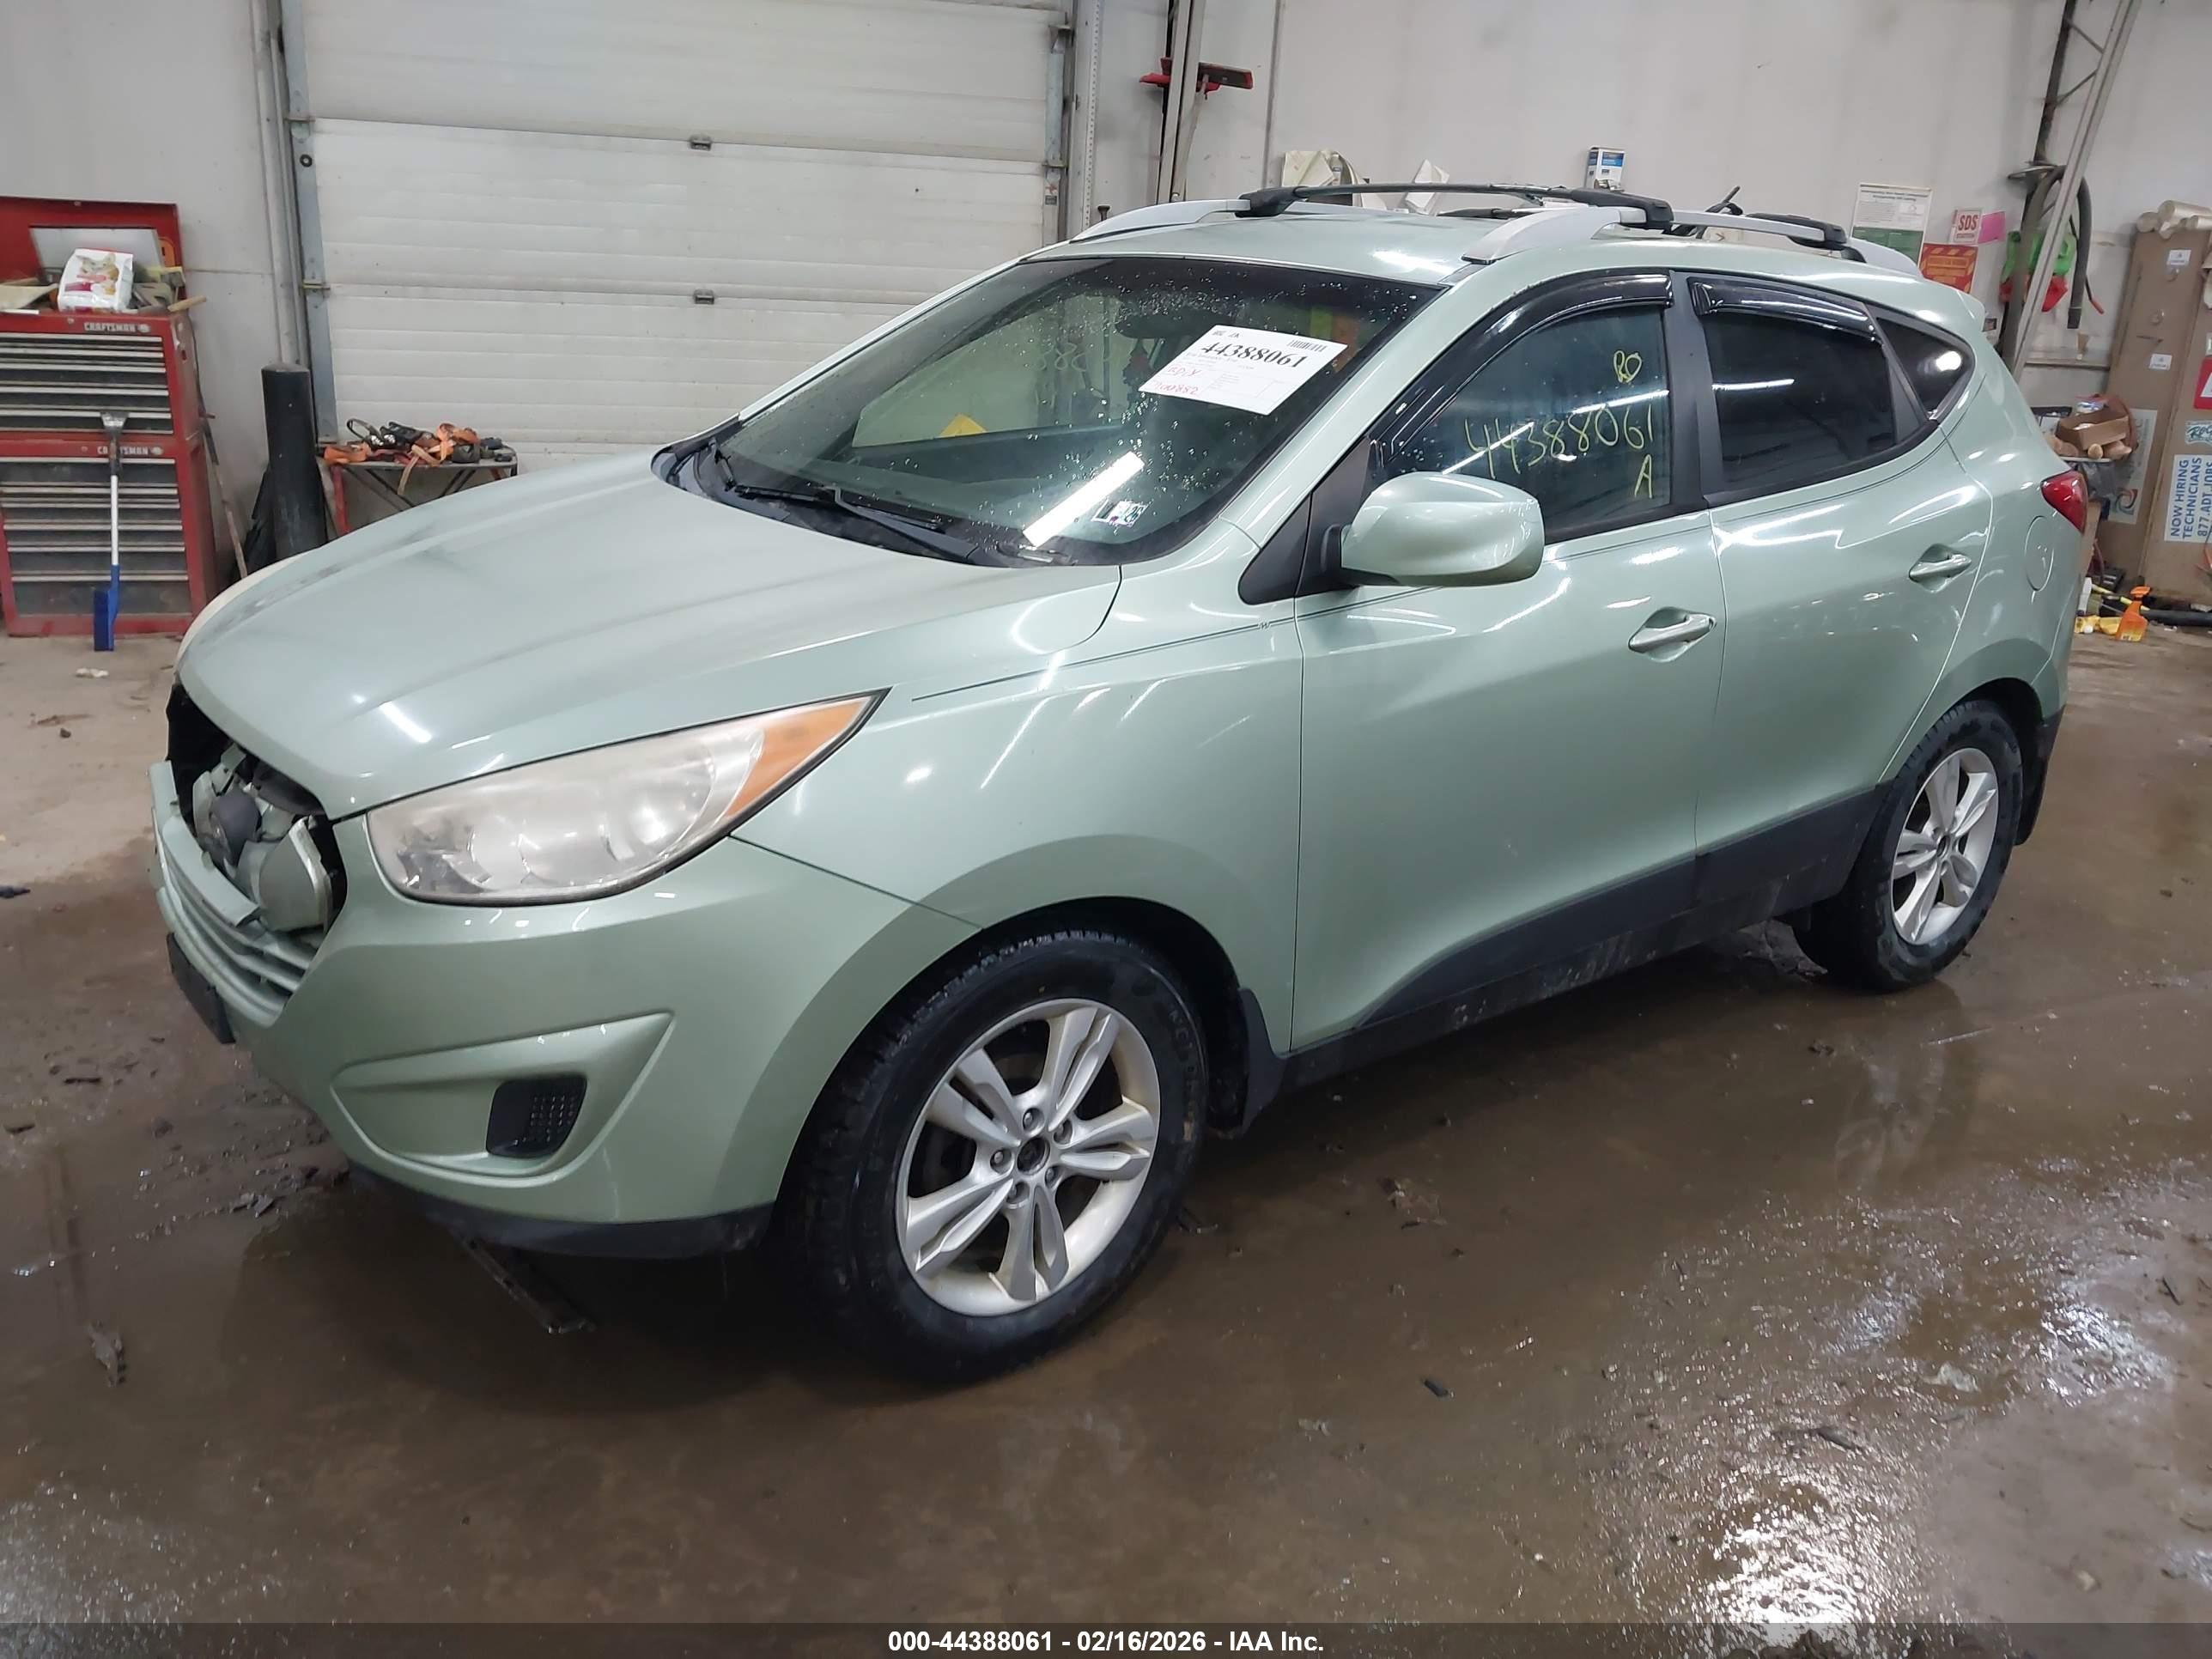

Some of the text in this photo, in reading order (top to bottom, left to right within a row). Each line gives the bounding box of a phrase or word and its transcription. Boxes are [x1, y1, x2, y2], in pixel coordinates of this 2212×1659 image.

[1958, 215, 1978, 231] SDS
[1201, 342, 1309, 369] 44388061
[1465, 403, 1654, 479] 44388061
[1634, 454, 1653, 498] A
[2170, 459, 2190, 537] NOW HIRING
[2182, 457, 2203, 539] TECHNICIANS
